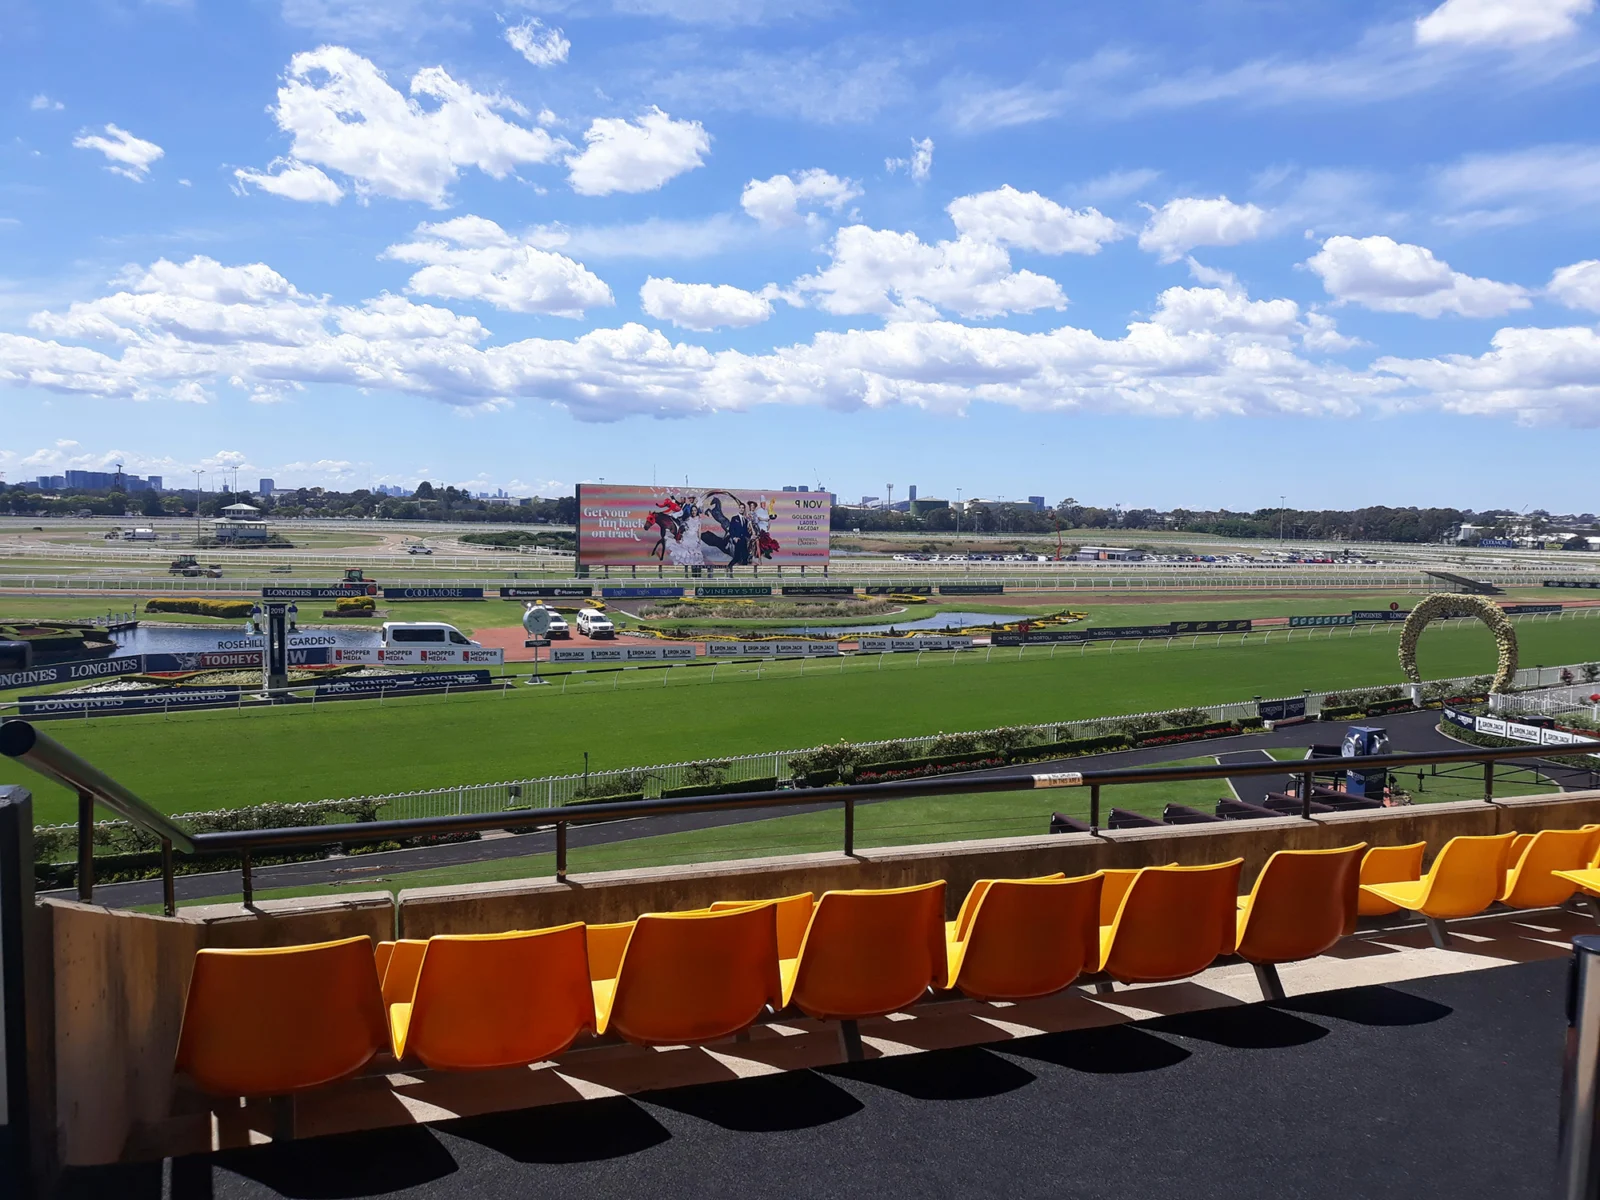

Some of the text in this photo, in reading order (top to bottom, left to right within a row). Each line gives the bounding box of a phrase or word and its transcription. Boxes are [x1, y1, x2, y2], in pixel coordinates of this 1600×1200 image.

[795, 500, 822, 508] 9 NOV
[584, 508, 631, 519] Get your
[599, 517, 644, 530] fun back
[608, 528, 641, 542] track
[404, 588, 463, 598] COOLMORE
[218, 636, 336, 649] ROSEHILL GARDENS
[204, 654, 260, 665] TOOHEYS
[70, 659, 137, 678] LONGINES
[0, 669, 57, 686] NGINES
[34, 696, 124, 711] LONGINES
